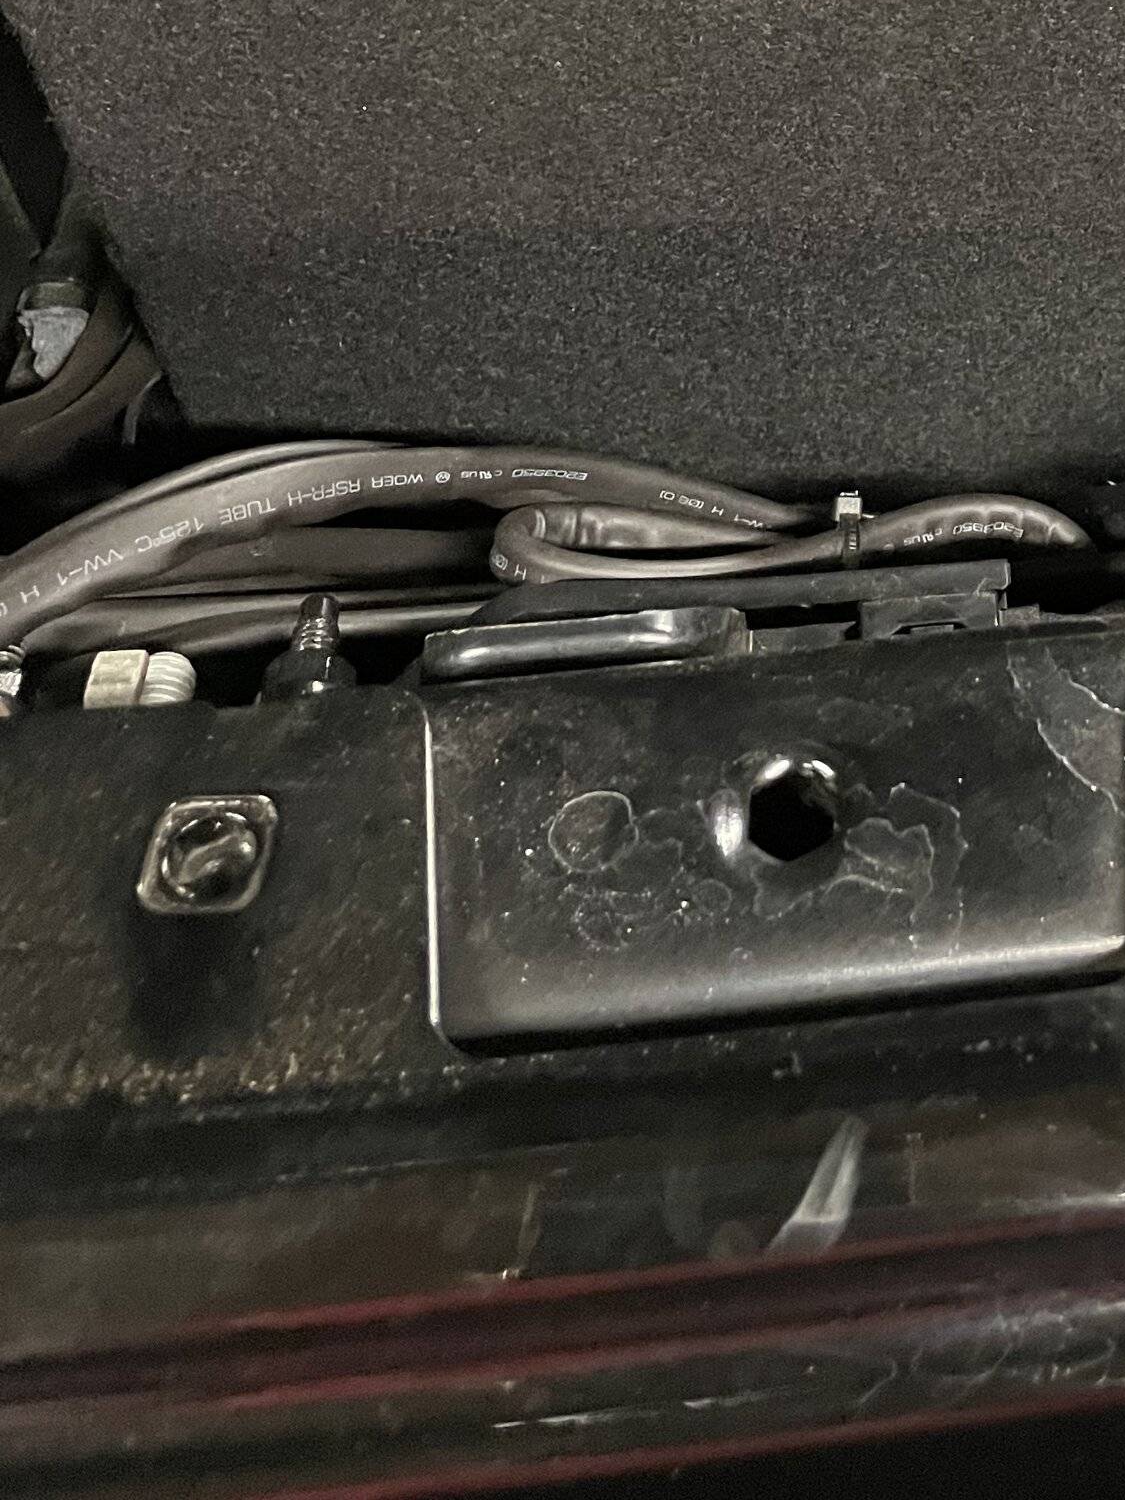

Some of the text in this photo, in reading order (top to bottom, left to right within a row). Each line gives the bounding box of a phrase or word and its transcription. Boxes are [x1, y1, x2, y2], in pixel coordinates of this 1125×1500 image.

[287, 477, 361, 506] RSFR-H
[371, 473, 424, 488] WOER
[219, 497, 276, 525] TUBE
[56, 548, 124, 587] VW-1
[20, 584, 40, 604] H
